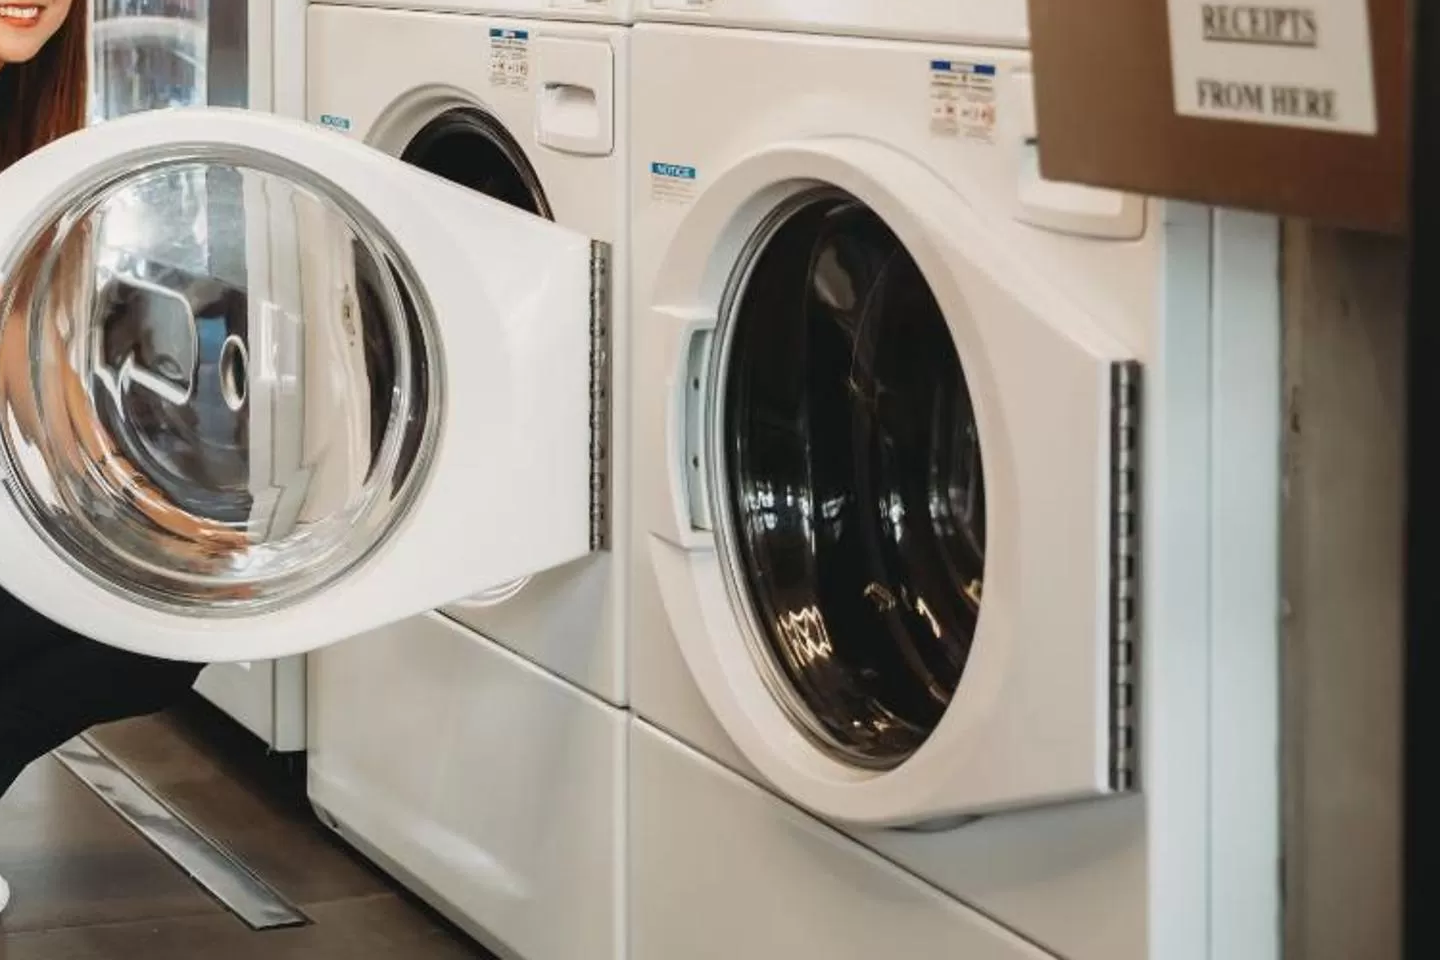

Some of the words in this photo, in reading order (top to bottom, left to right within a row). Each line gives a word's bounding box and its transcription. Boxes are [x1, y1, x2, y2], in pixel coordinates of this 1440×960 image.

[1201, 4, 1317, 43] RECEIPTS
[1197, 77, 1265, 113] FROM
[1271, 85, 1337, 121] HERE
